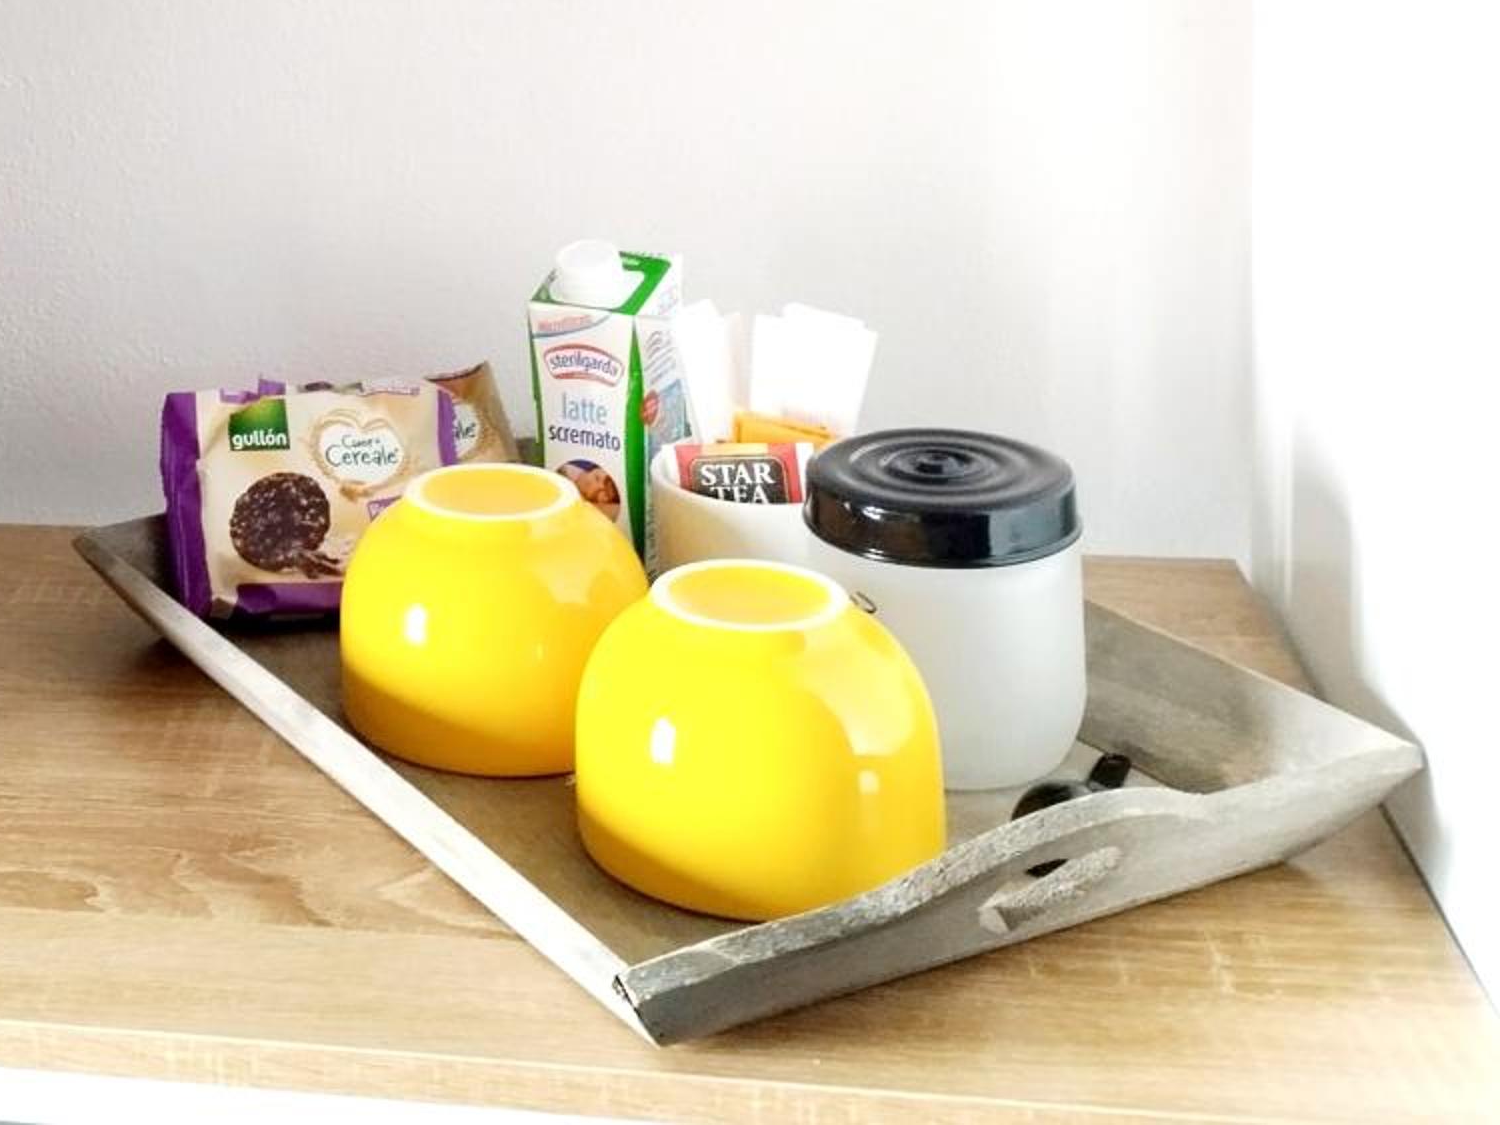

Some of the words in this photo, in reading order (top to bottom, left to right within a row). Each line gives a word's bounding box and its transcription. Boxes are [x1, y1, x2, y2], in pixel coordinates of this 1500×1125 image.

[549, 350, 618, 377] sterilgarda
[562, 391, 608, 425] latte
[232, 428, 288, 450] gullón
[548, 424, 621, 452] scremato
[325, 444, 397, 467] Cereale
[700, 461, 775, 486] STAR
[710, 485, 770, 504] TEA
